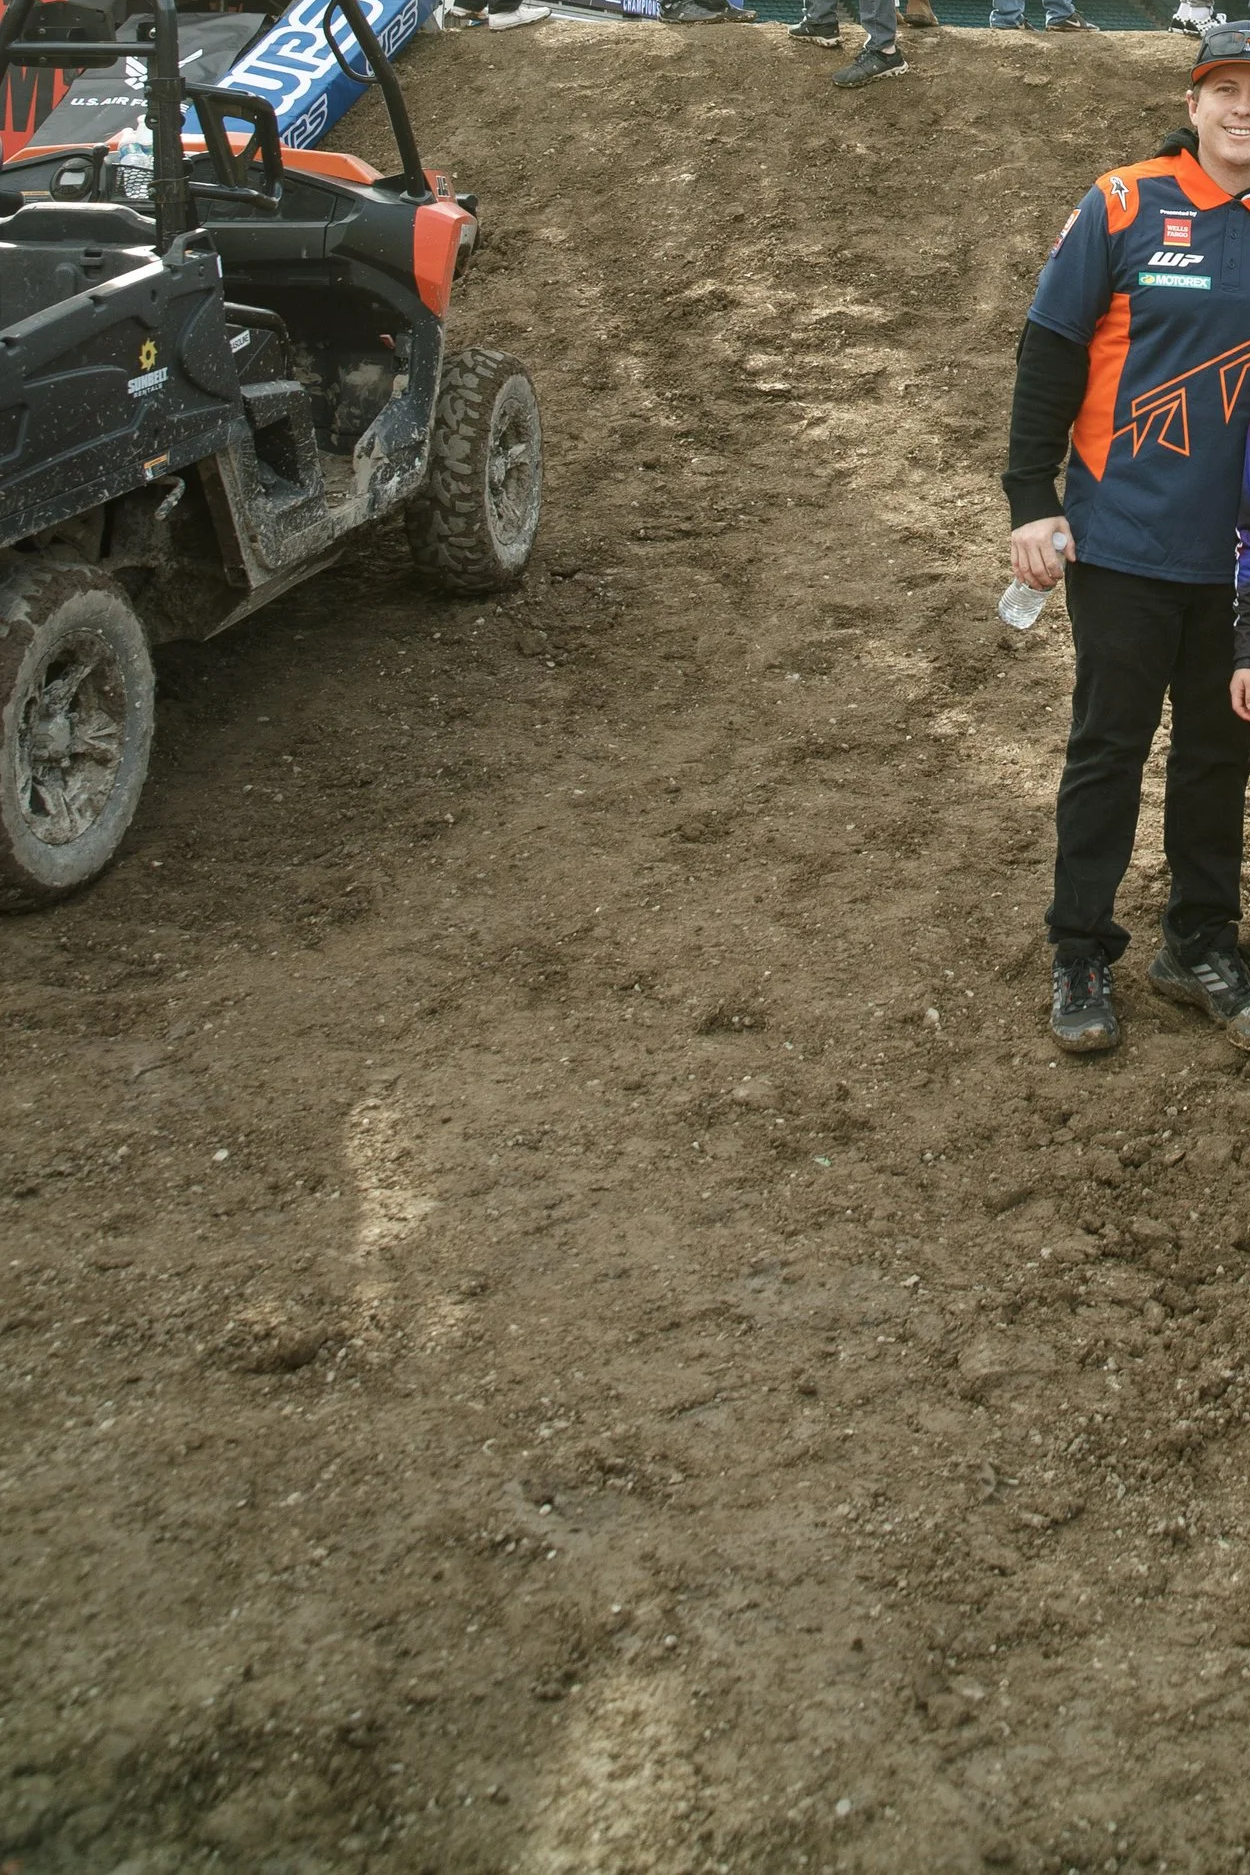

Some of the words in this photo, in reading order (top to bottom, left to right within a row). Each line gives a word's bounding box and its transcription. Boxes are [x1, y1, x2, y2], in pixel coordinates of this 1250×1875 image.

[70, 98, 99, 106] U.S.
[102, 96, 130, 106] AIR
[1159, 209, 1188, 217] Presented
[1189, 210, 1198, 218] by
[1166, 224, 1188, 233] WELLS
[1166, 231, 1189, 239] FARGO
[1148, 251, 1205, 268] WP
[1155, 274, 1210, 289] MOTOREX
[231, 335, 250, 349] ASOLINE
[128, 367, 169, 395] SUNBELT
[133, 382, 163, 399] RENTALS
